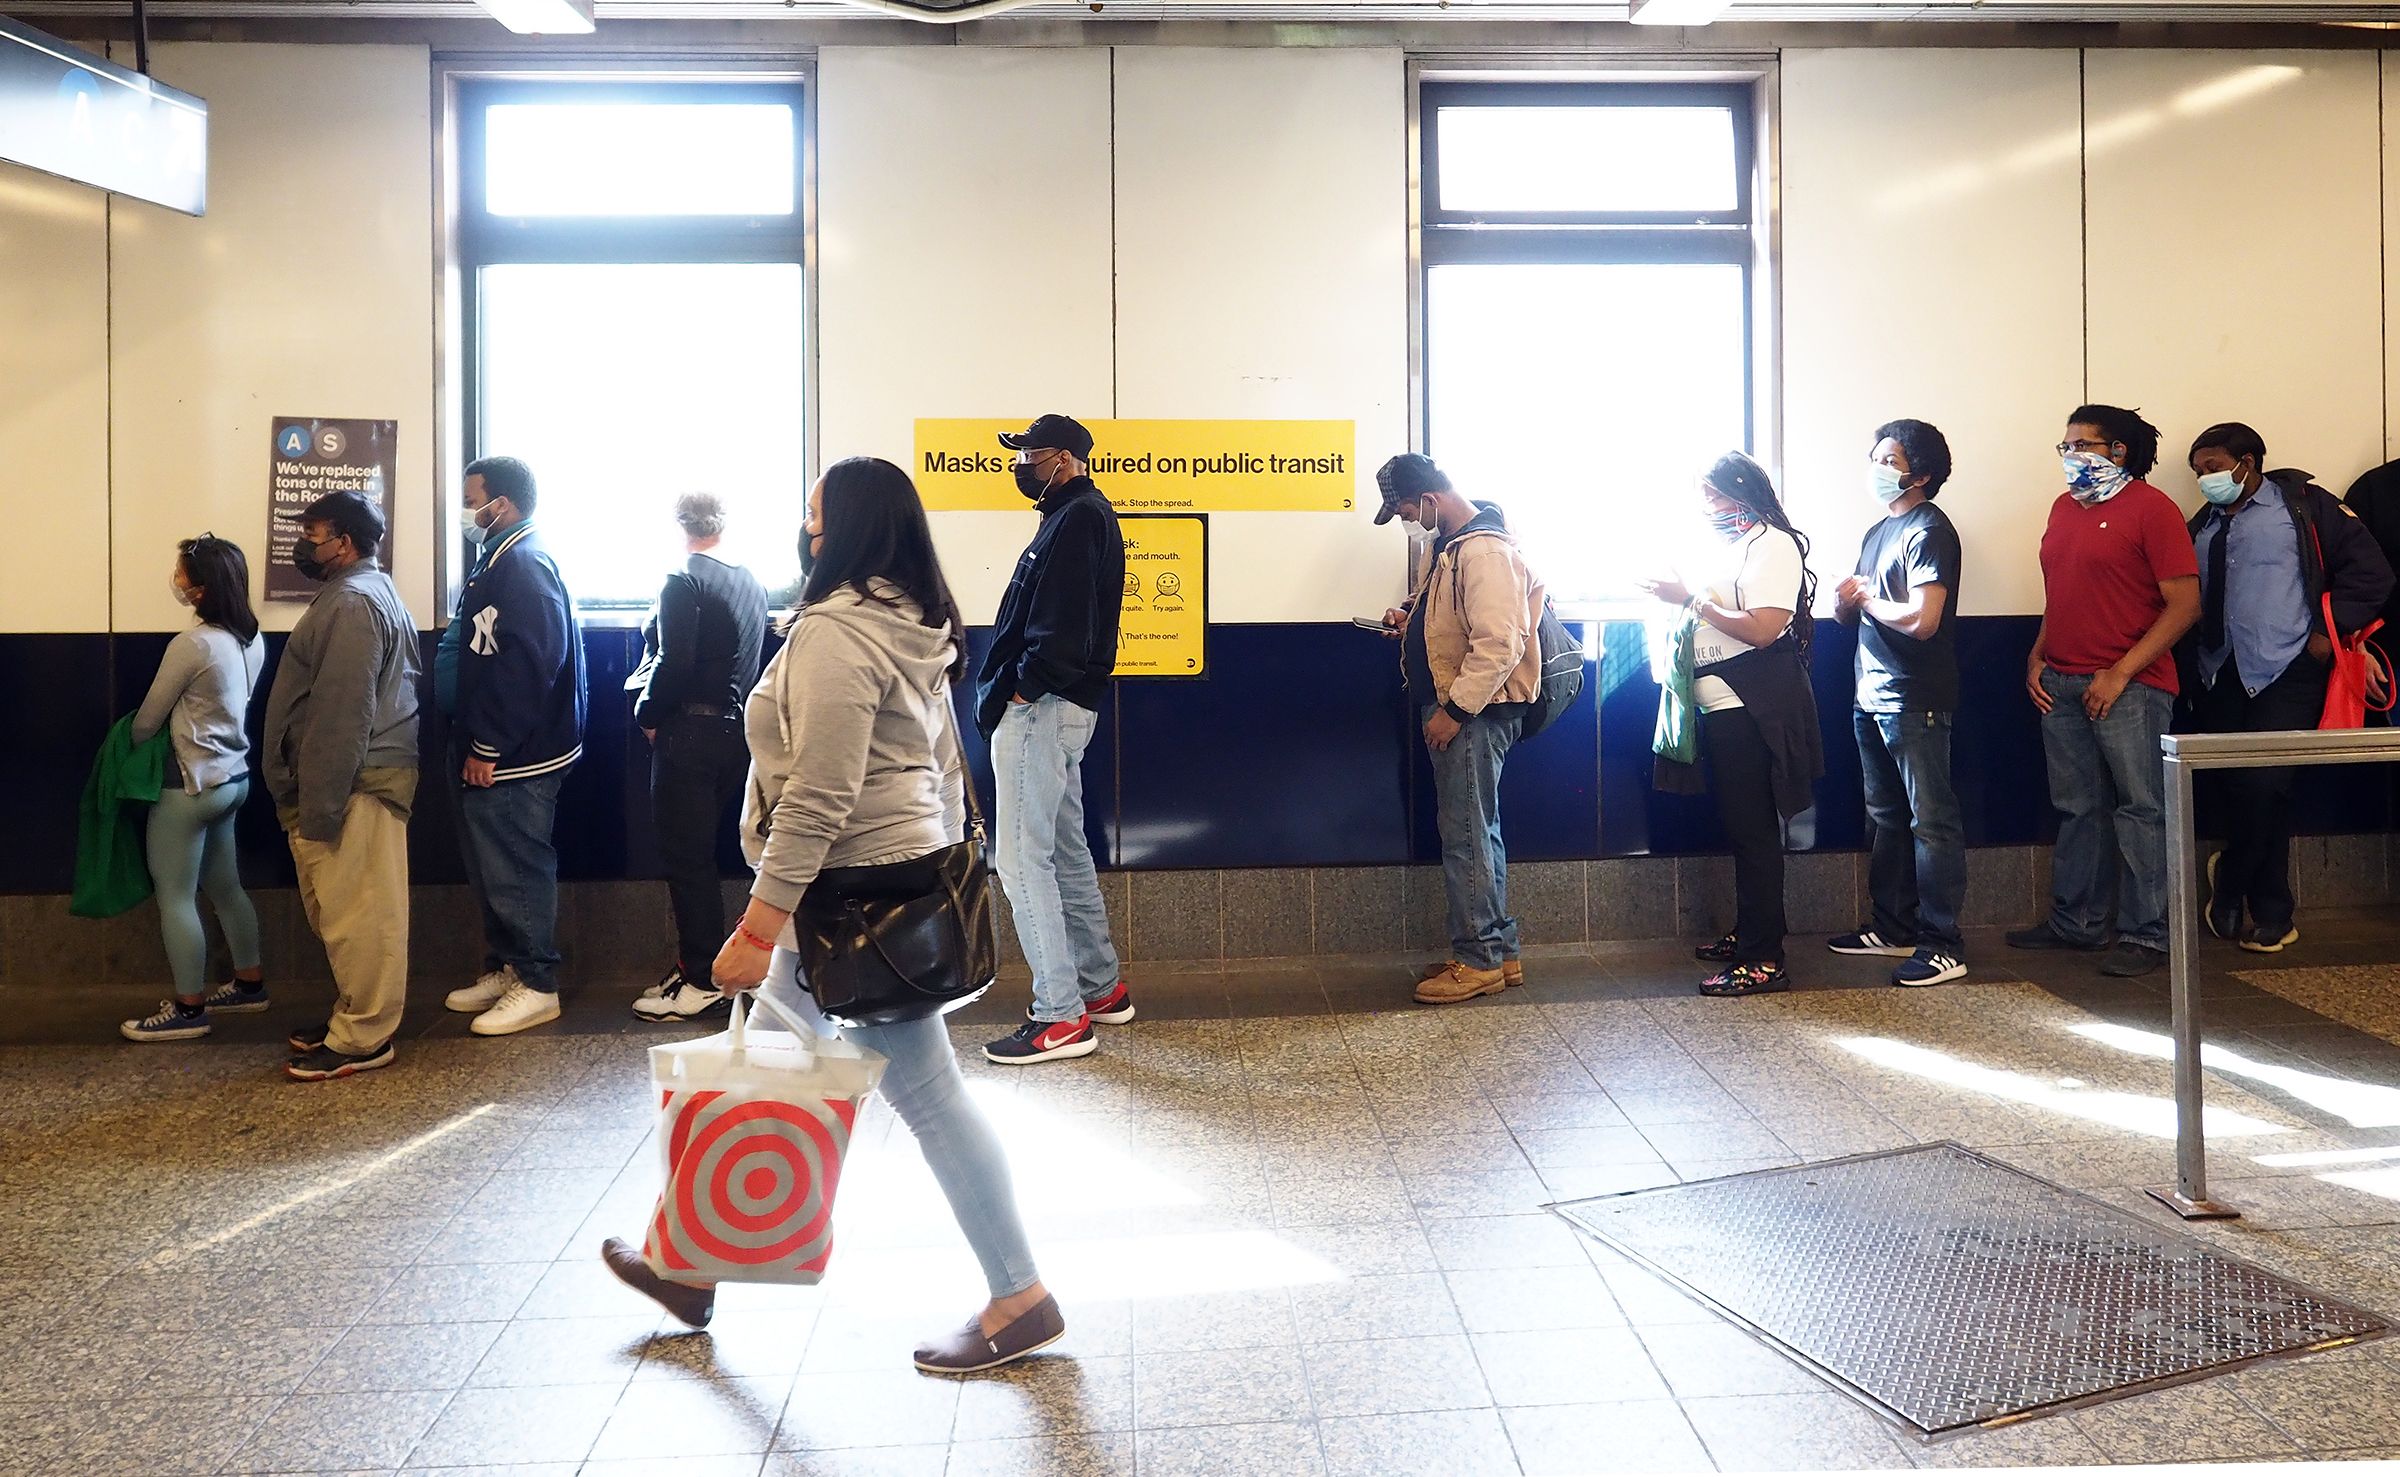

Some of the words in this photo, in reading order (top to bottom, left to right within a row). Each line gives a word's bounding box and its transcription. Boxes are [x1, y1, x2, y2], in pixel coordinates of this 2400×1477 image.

[286, 433, 301, 450] A
[323, 433, 338, 452] S
[276, 462, 319, 475] We've
[320, 464, 380, 478] replaced
[925, 452, 1001, 473] Masks
[1156, 457, 1187, 473] on
[1192, 453, 1264, 477] public
[1269, 453, 1344, 473] transit
[276, 477, 307, 489] tons
[308, 477, 323, 489] of
[326, 478, 361, 490] track
[363, 479, 375, 490] in
[275, 490, 298, 502] the
[1129, 499, 1148, 508] Stop
[1150, 499, 1163, 507] the
[1164, 499, 1194, 508] spread.
[274, 507, 305, 517] Pressin
[273, 524, 296, 533] things
[1122, 538, 1139, 549] sk:
[1132, 552, 1149, 560] and
[1151, 552, 1180, 560] mouth.
[469, 605, 499, 656] NY
[1694, 647, 1707, 659] VE
[1709, 646, 1722, 658] ON
